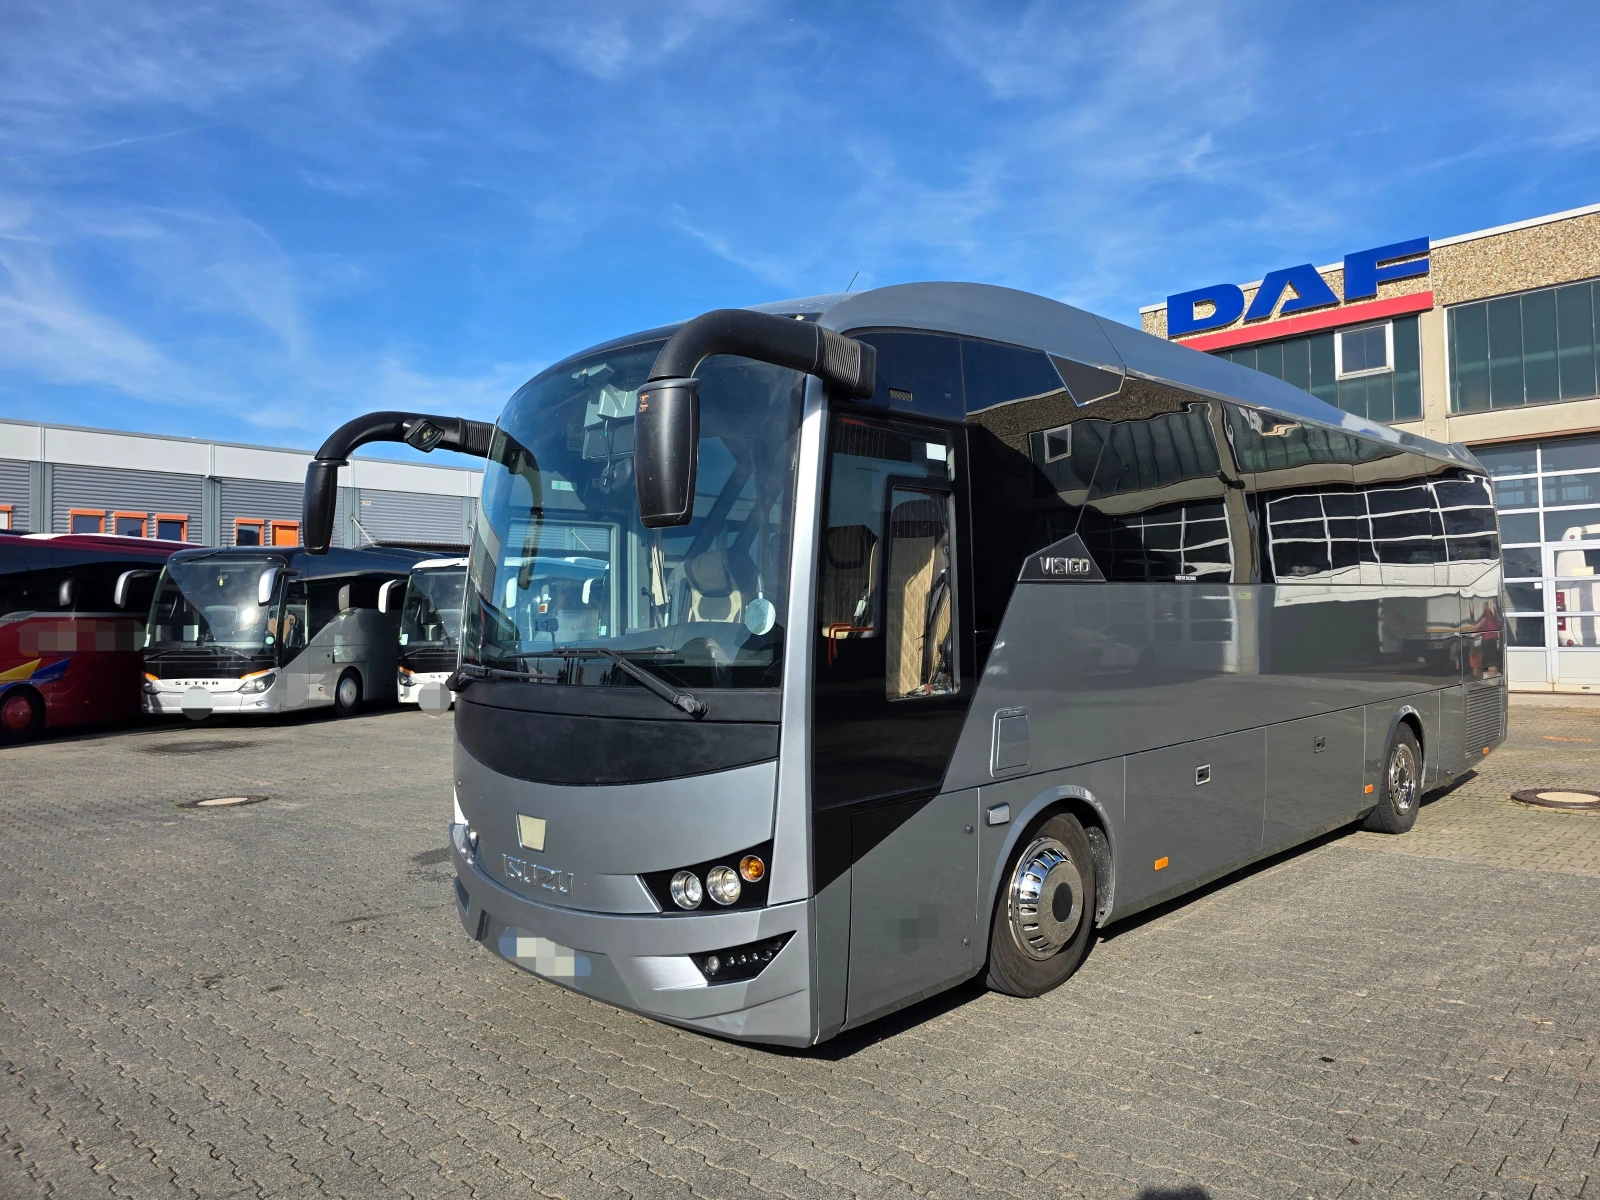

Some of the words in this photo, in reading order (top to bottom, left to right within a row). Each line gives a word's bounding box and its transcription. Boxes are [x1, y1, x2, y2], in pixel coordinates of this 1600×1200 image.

[1167, 236, 1430, 337] DAF
[1039, 556, 1091, 575] VISIGO
[502, 853, 574, 896] ISUZU
